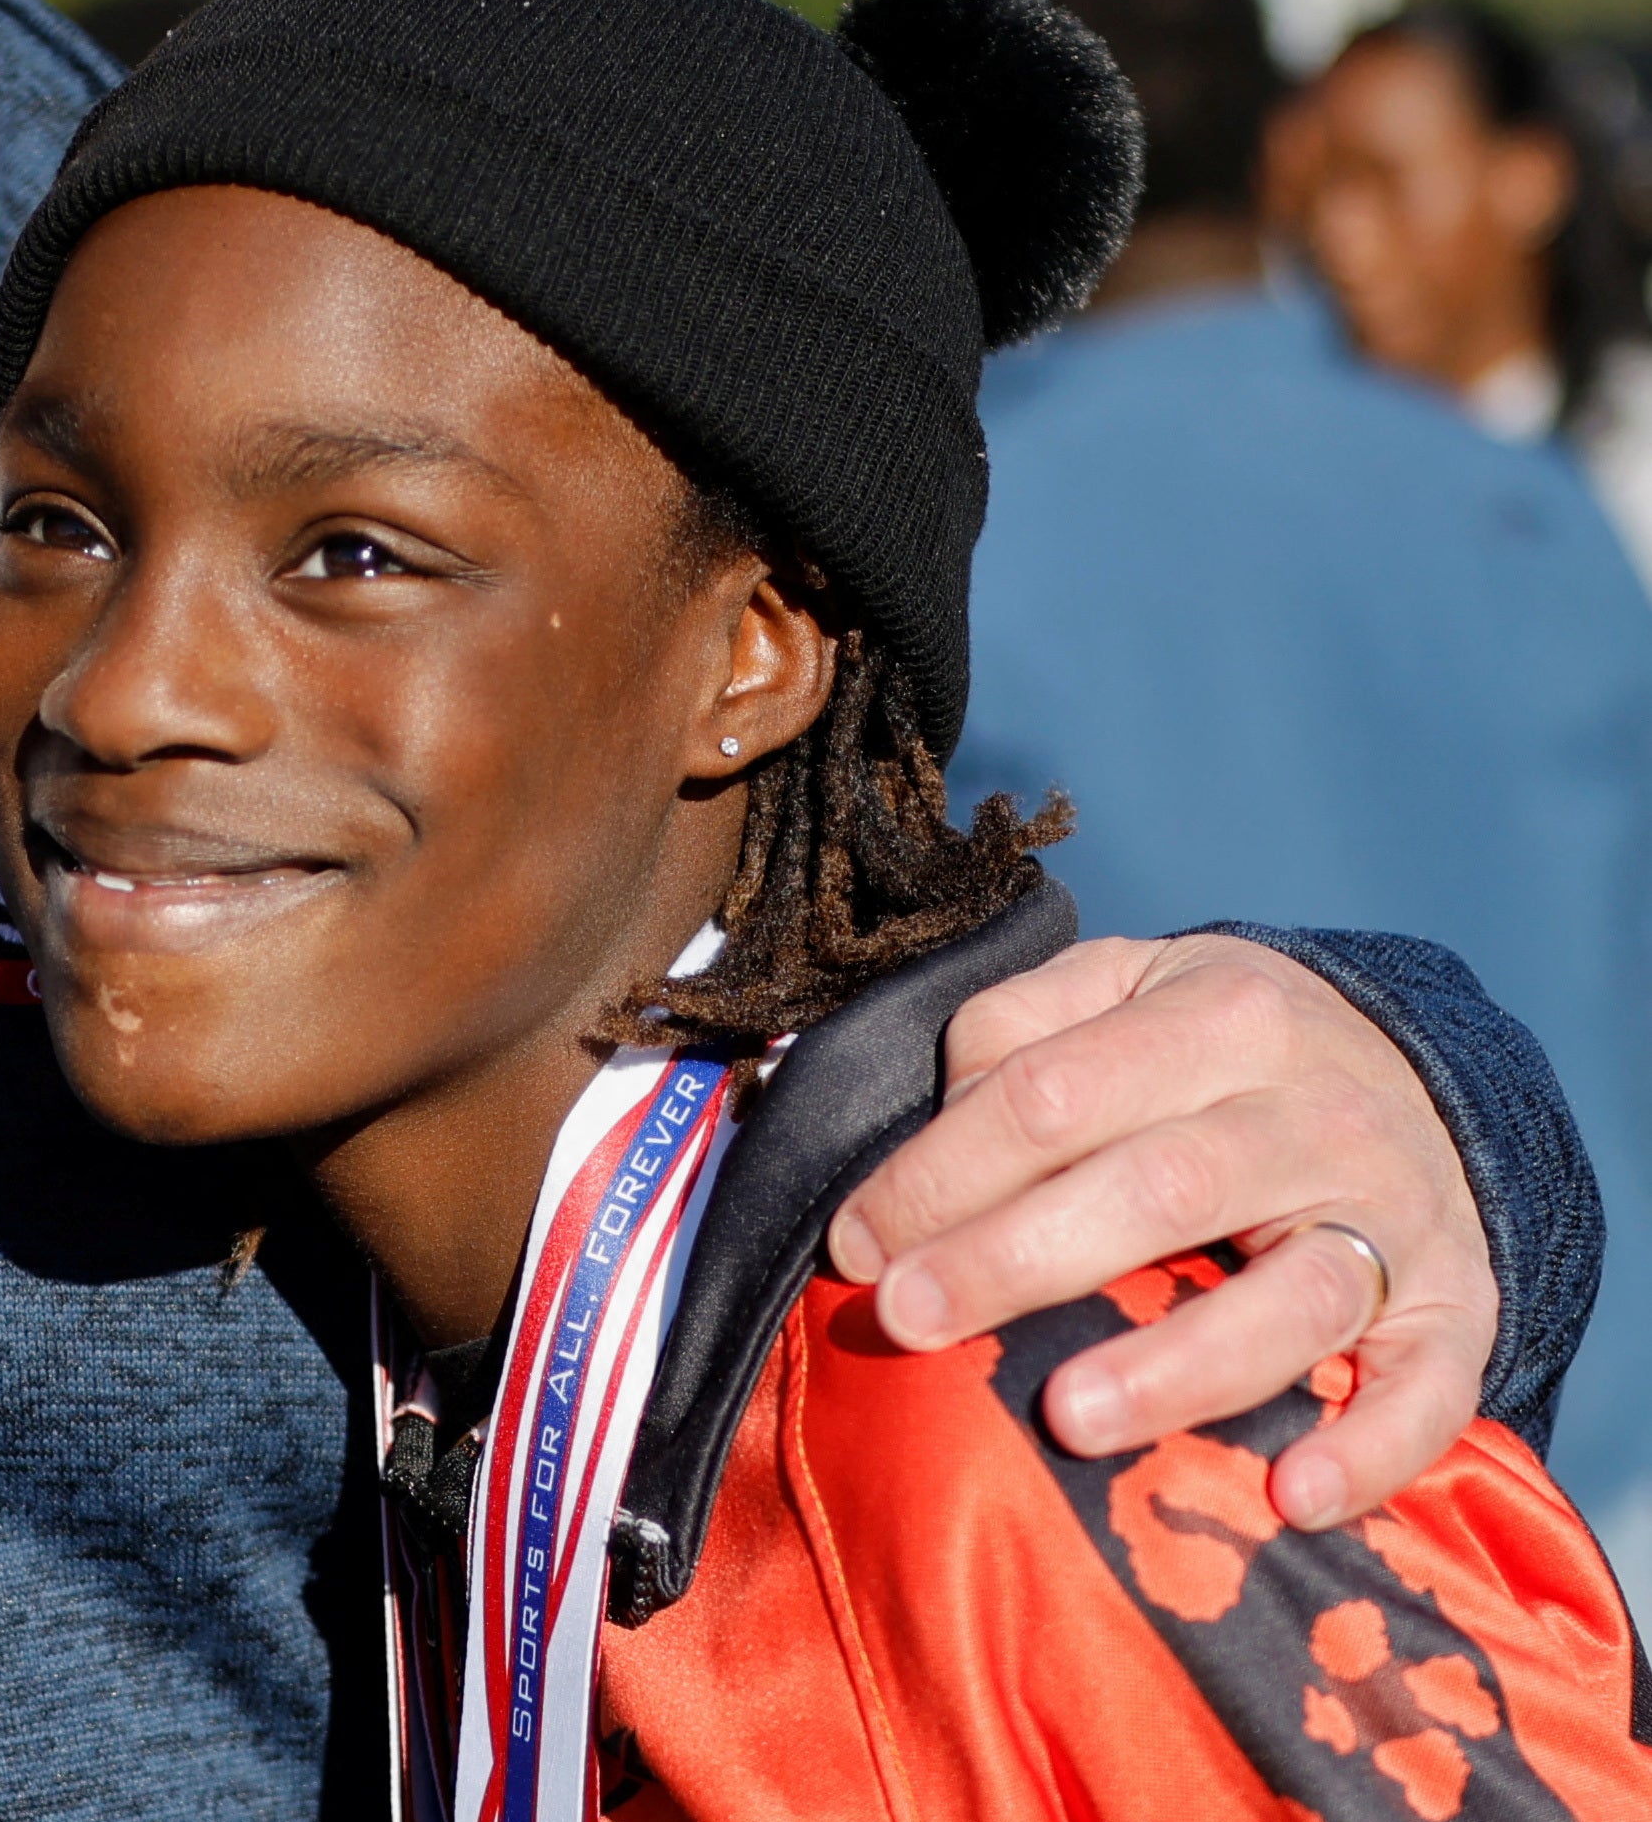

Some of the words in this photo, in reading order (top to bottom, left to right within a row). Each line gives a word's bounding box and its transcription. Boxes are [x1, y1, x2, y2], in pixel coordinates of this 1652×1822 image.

[512, 1545, 545, 1742] SPORTS
[531, 1425, 561, 1522] FOR
[547, 1293, 600, 1403] ALL,
[585, 1073, 706, 1265] FOREVER
